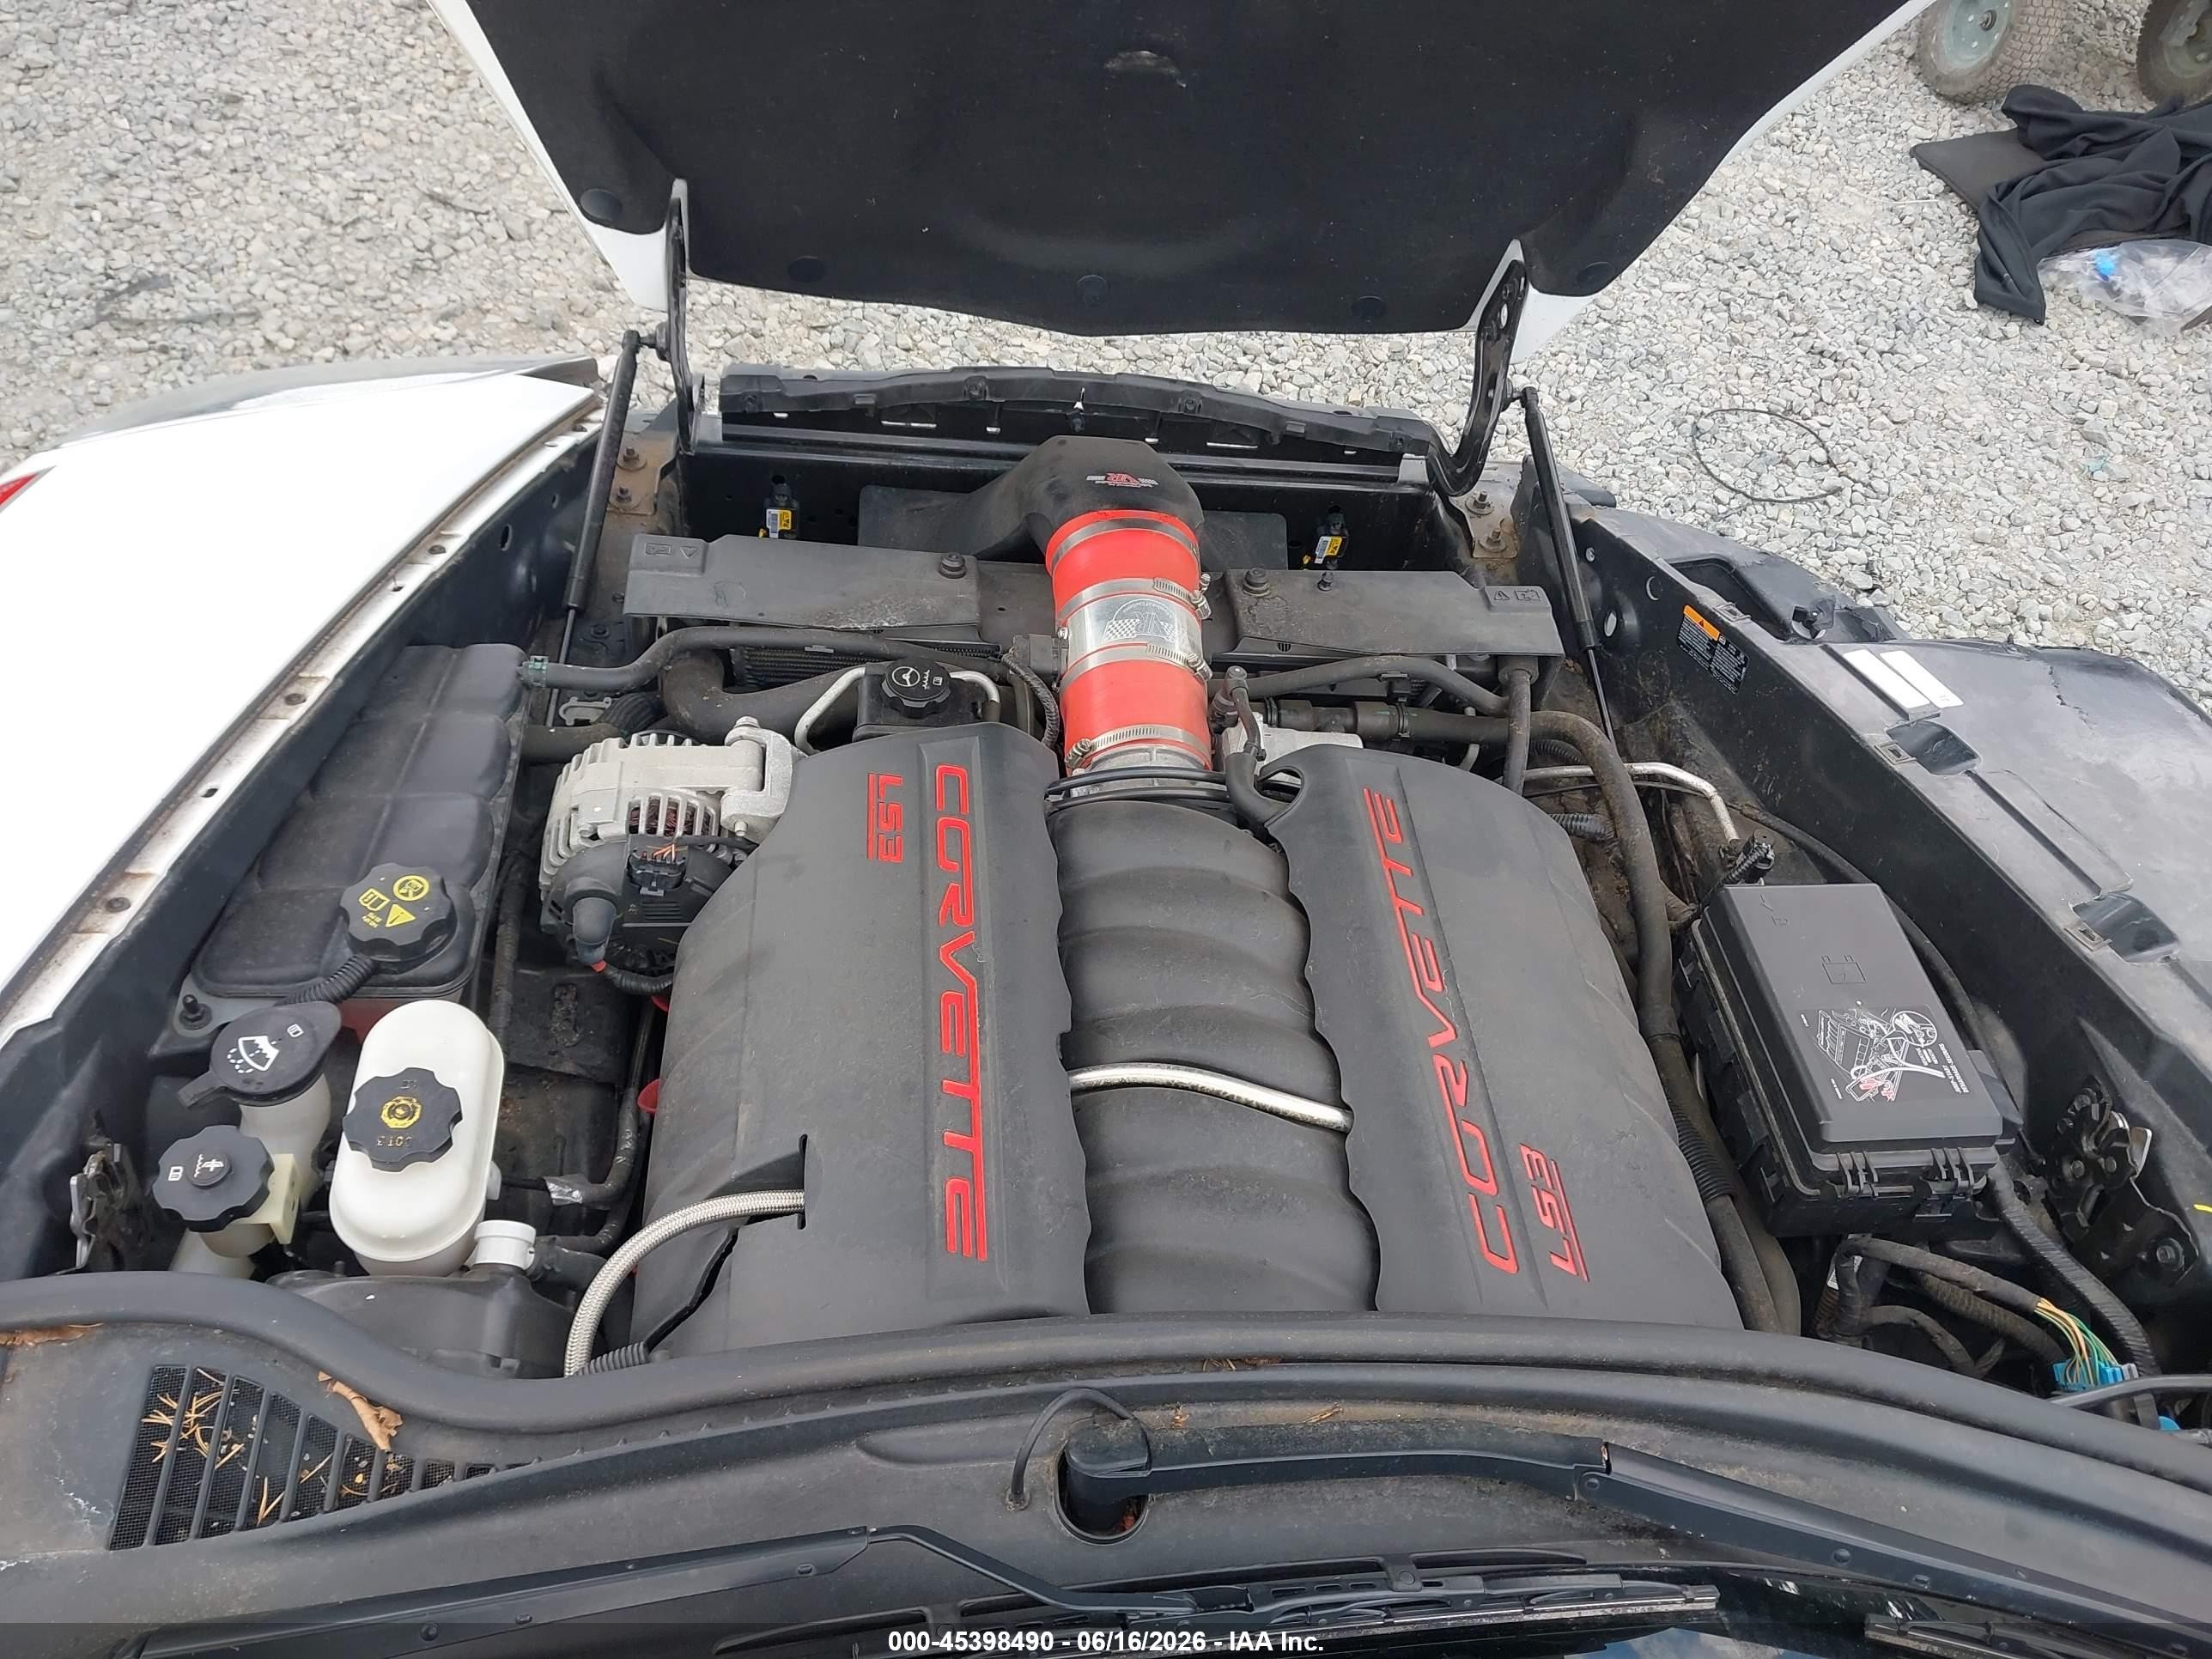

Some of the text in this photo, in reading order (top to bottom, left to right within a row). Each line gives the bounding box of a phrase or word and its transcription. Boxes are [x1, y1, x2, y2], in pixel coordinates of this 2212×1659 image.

[876, 773, 903, 863] LS3
[935, 763, 988, 1261] CORVETTE
[1363, 787, 1519, 1274] CORVETTE
[1520, 1142, 1579, 1278] LS3
